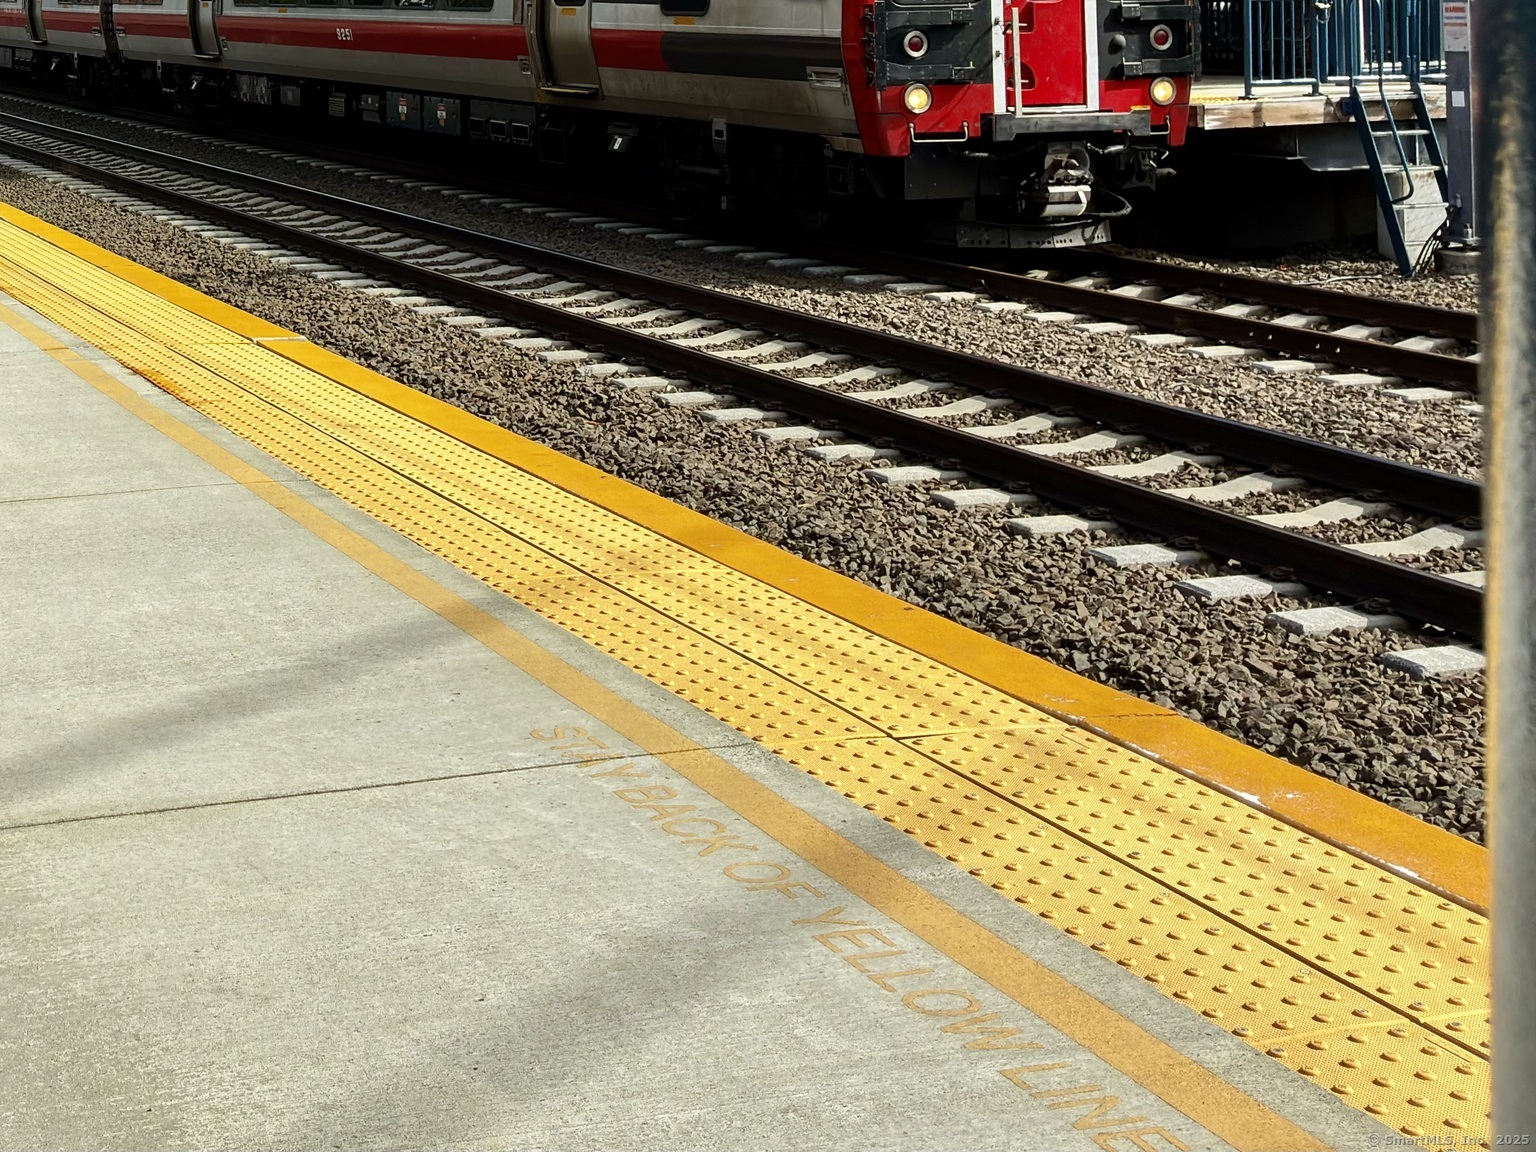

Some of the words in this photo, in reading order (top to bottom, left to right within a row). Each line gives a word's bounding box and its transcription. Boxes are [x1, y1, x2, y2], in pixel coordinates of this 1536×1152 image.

[336, 27, 354, 41] 9251
[529, 725, 652, 779] STAY
[613, 784, 759, 857] BACK
[722, 860, 826, 900] OF
[791, 906, 1045, 1051] YELLOW
[1000, 1062, 1193, 1152] LINE
